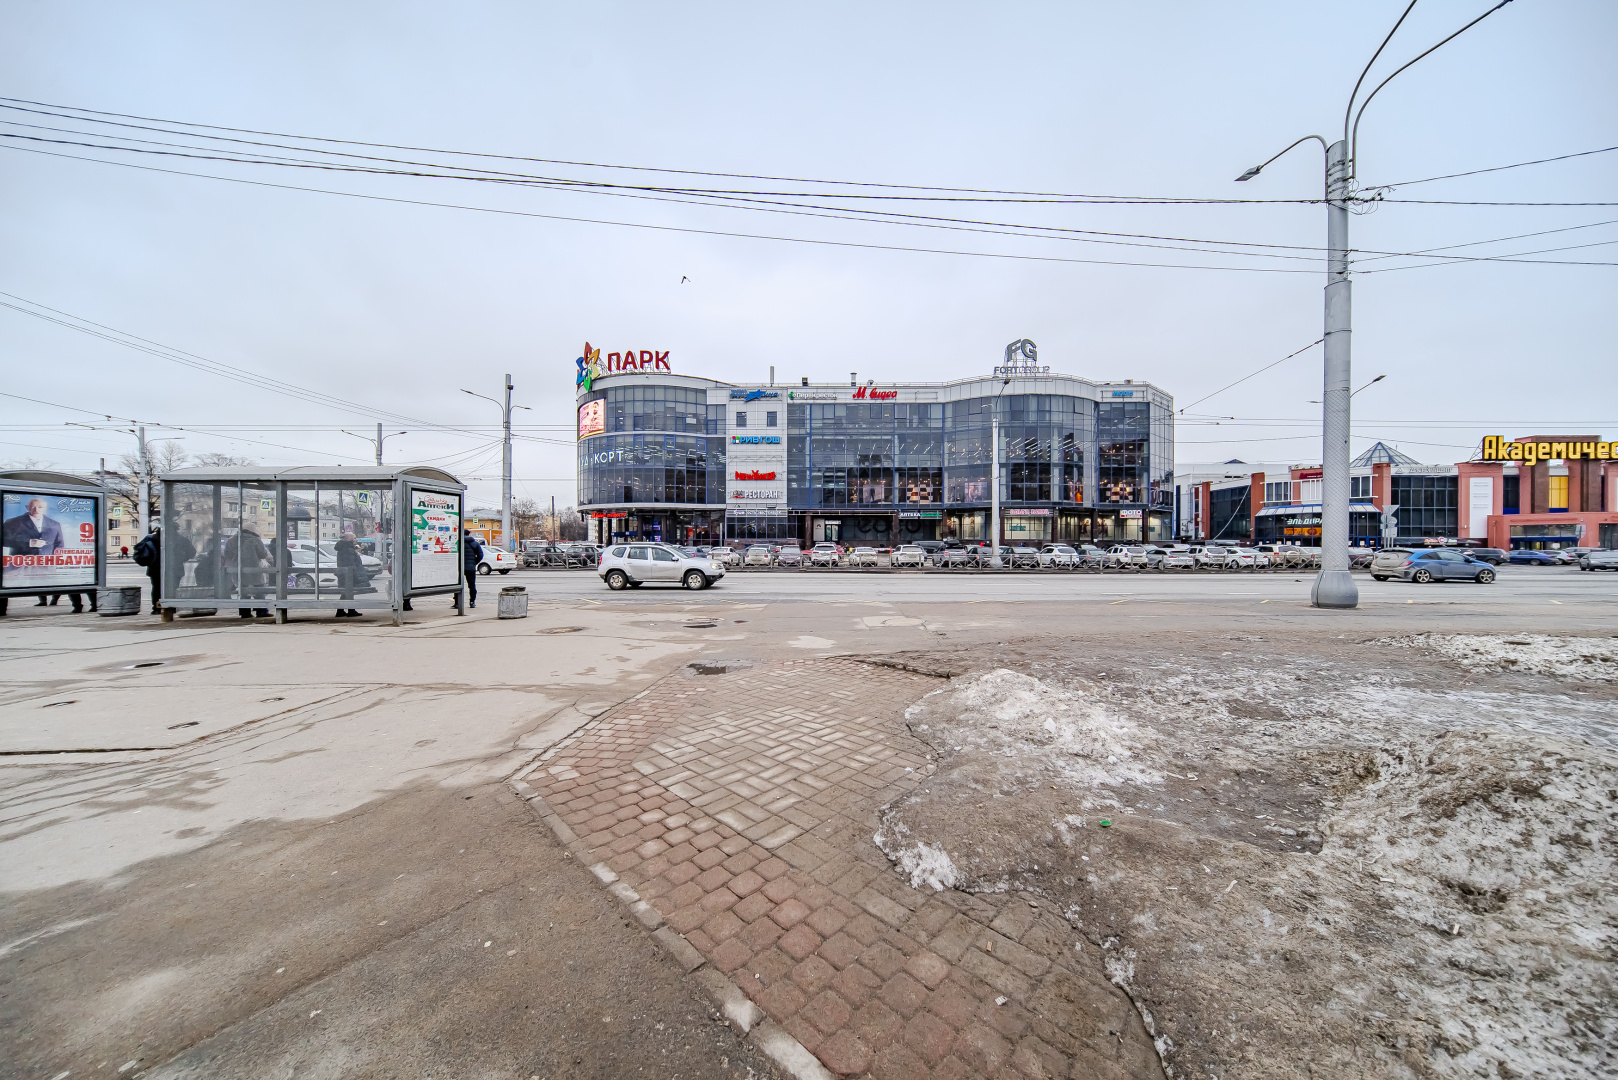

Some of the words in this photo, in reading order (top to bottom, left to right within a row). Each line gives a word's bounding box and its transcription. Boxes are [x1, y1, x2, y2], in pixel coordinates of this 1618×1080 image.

[1007, 338, 1037, 362] FG
[607, 350, 670, 372] ПАРК
[744, 490, 778, 499] РЕСТОРАН
[80, 522, 94, 538] 9
[3, 555, 95, 567] РОЗЕНБАУМ
